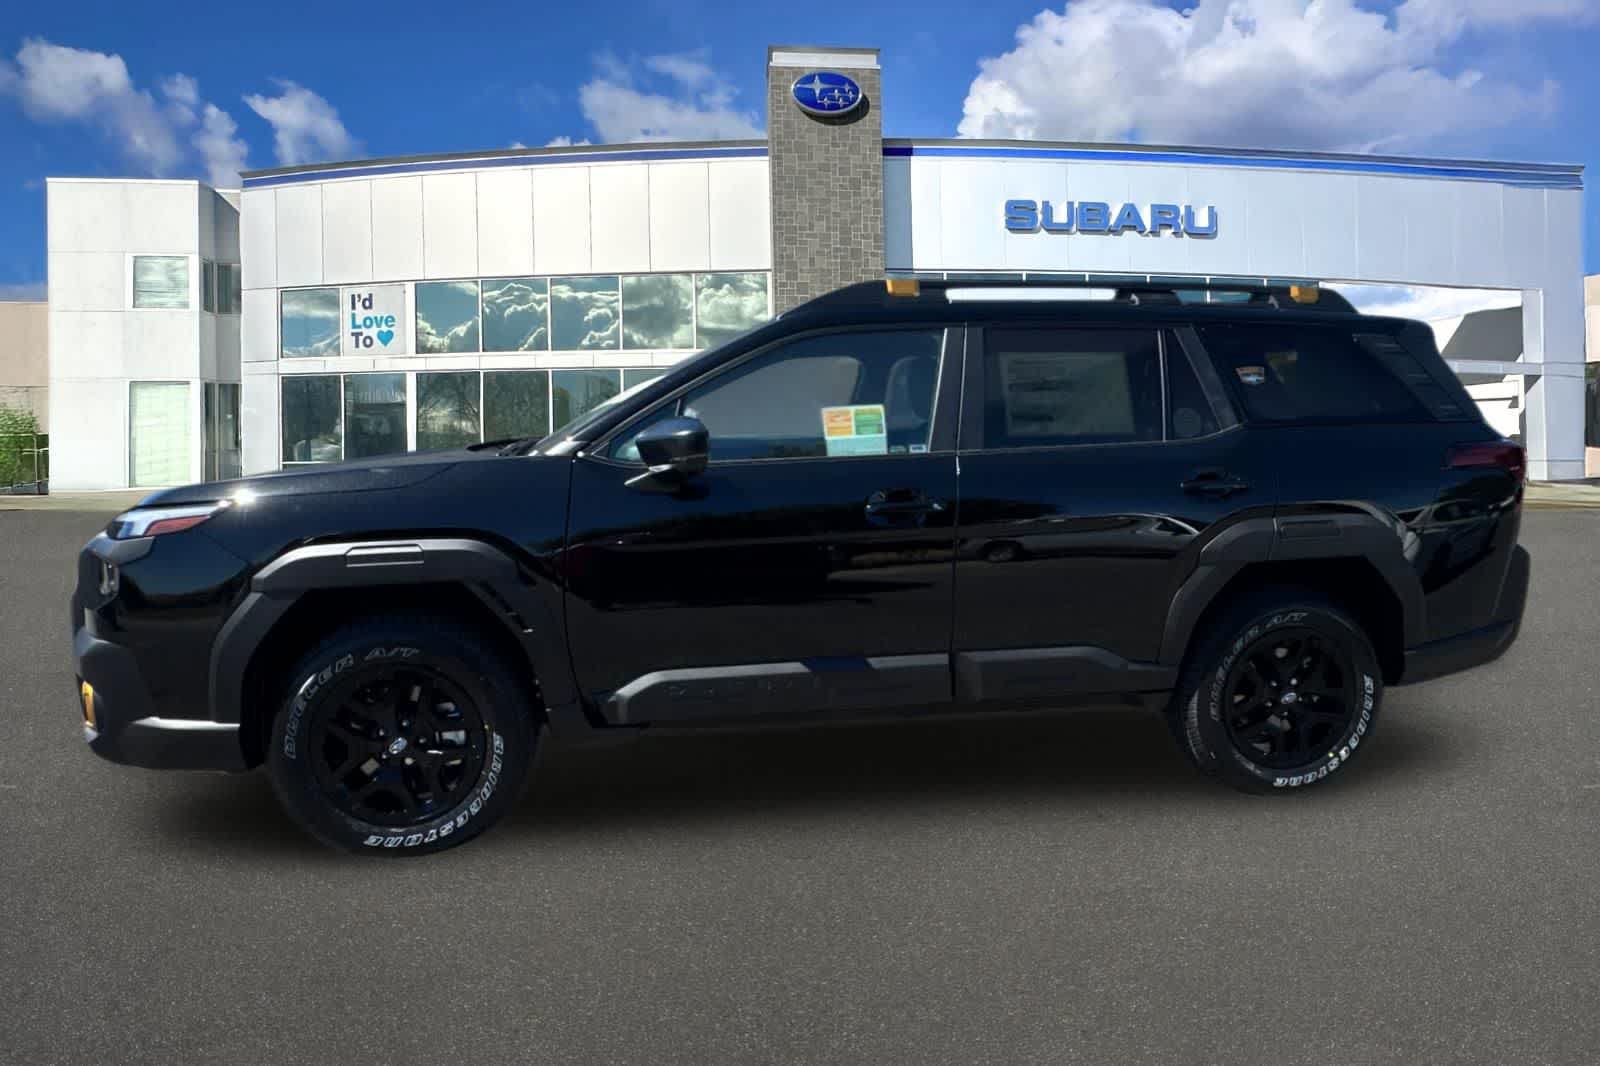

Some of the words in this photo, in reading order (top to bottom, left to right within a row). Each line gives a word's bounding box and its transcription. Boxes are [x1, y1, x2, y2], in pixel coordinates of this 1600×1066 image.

[1005, 199, 1217, 238] SUBARU
[351, 293, 373, 310] I'd
[351, 312, 396, 329] Love
[351, 331, 374, 348] To
[363, 731, 505, 848] BRIDGESTONE
